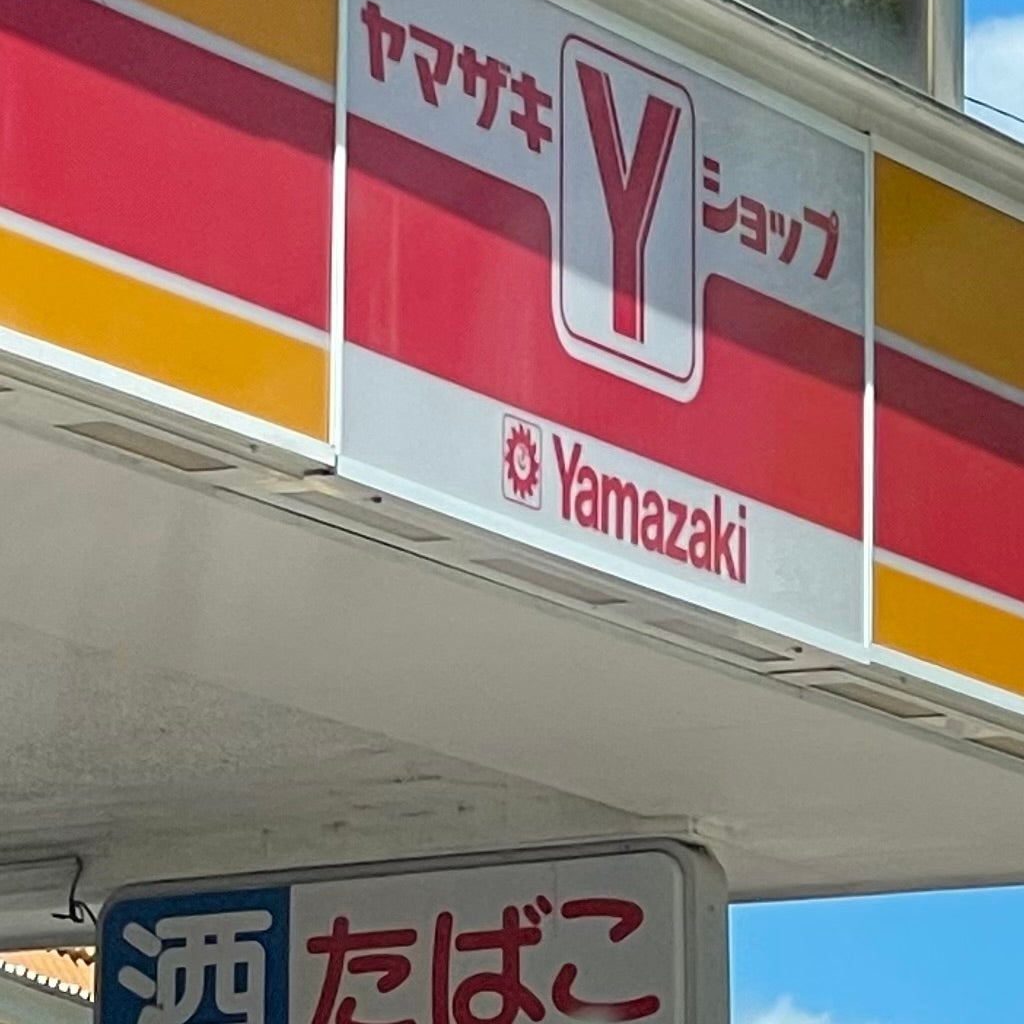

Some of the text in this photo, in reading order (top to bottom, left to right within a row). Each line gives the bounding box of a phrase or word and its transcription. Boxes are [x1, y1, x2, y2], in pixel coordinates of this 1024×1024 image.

[360, 0, 840, 344] ヤマザキ Y ショップ
[552, 432, 746, 585] Yamazaki
[117, 894, 660, 1024] 酒 たばこ
